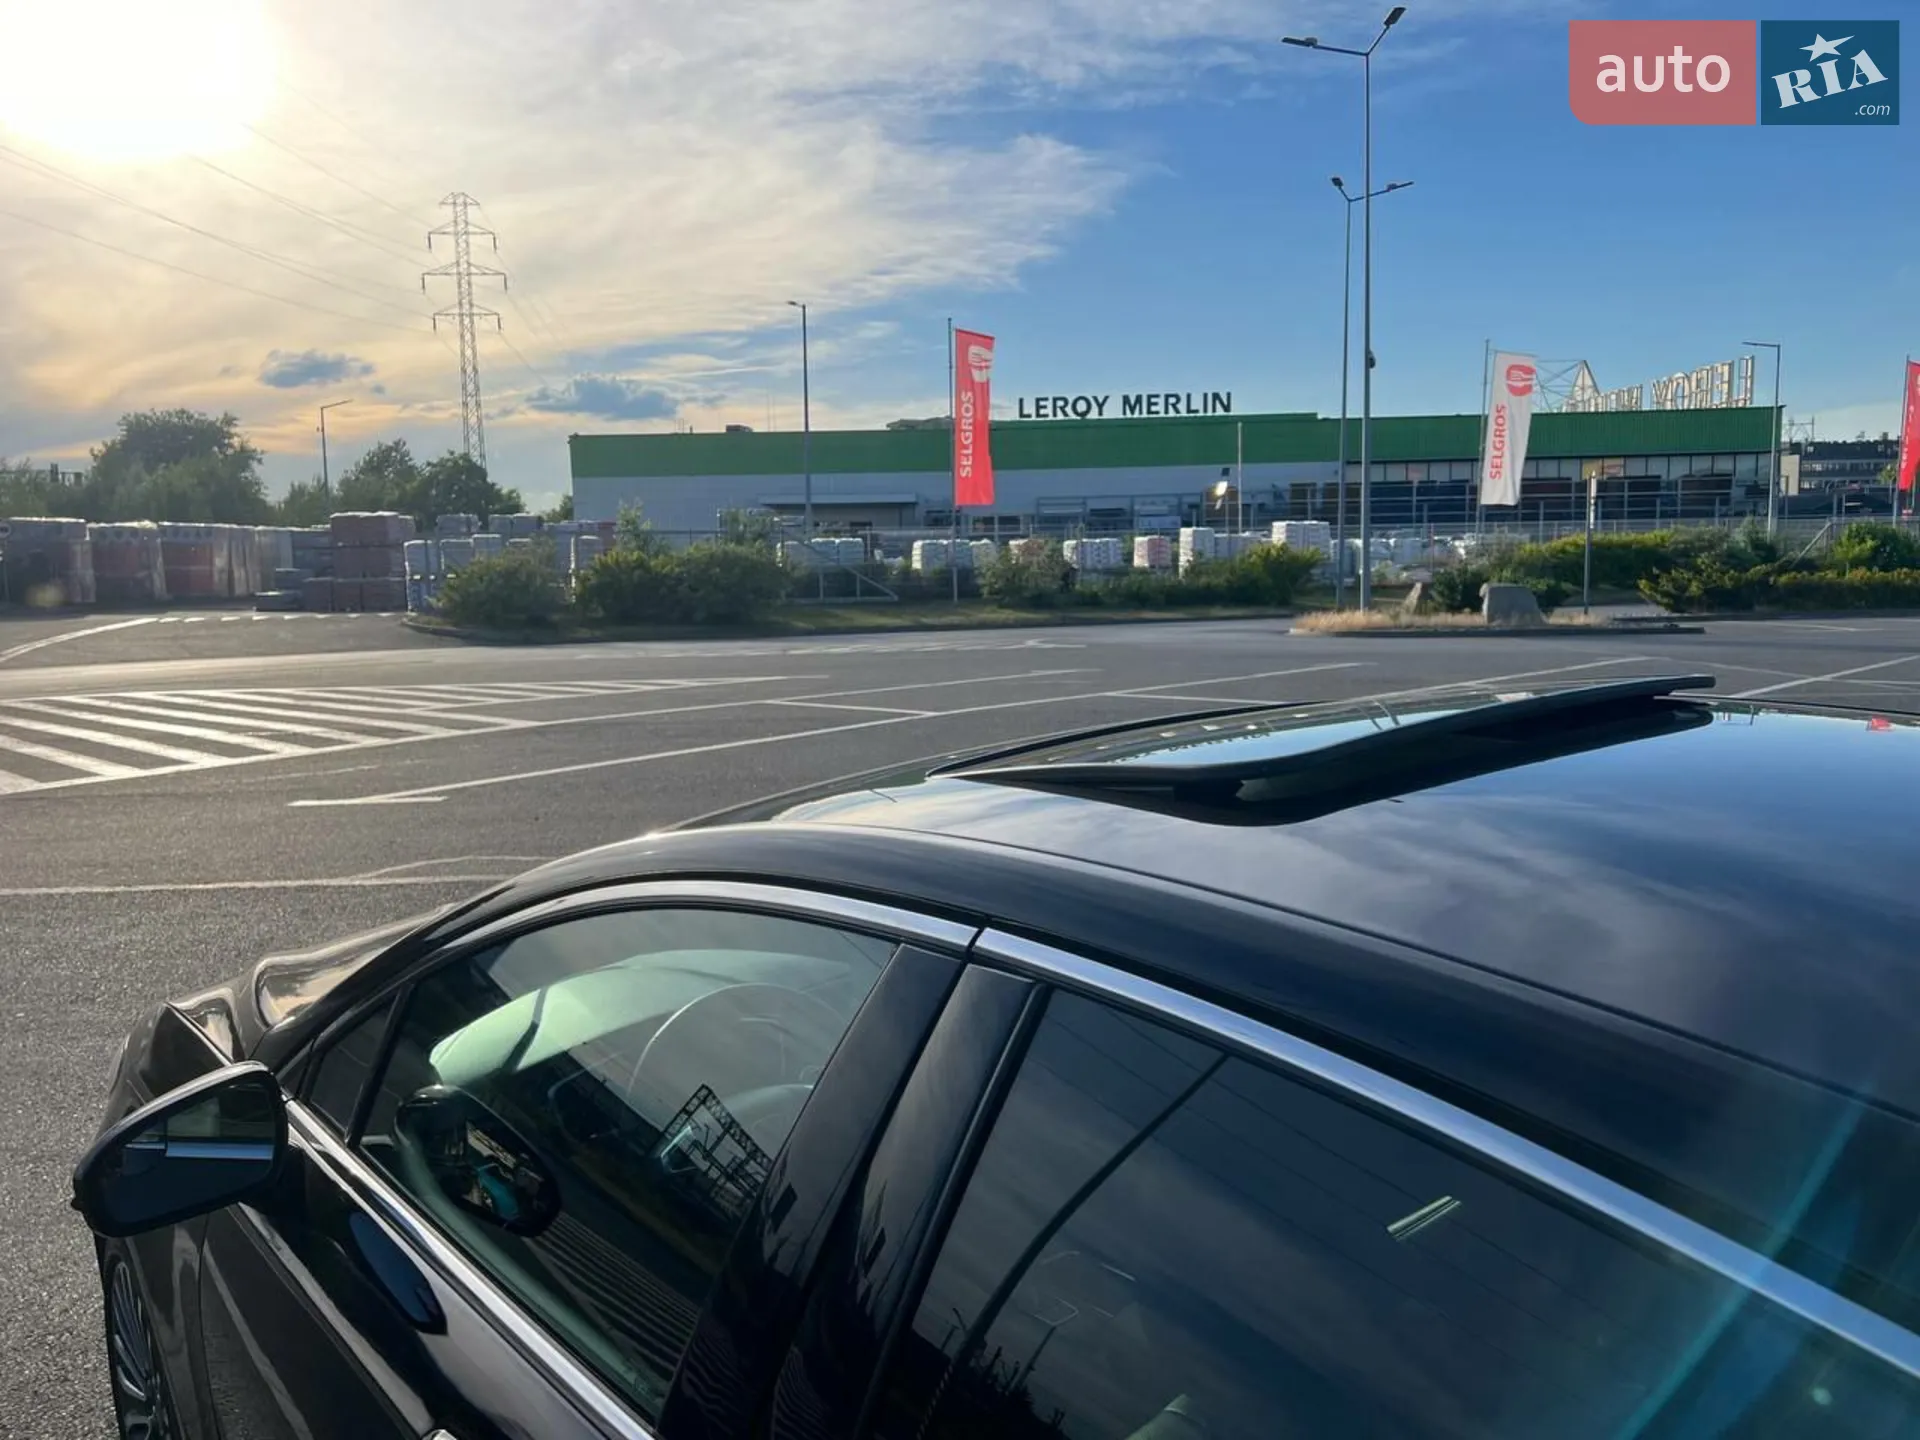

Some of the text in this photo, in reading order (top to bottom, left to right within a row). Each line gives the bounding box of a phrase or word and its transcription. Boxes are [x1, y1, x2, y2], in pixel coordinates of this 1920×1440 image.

[960, 390, 973, 478] SELGROS
[1018, 391, 1232, 419] LEROY MERLIN
[1489, 403, 1508, 481] SELGROS
